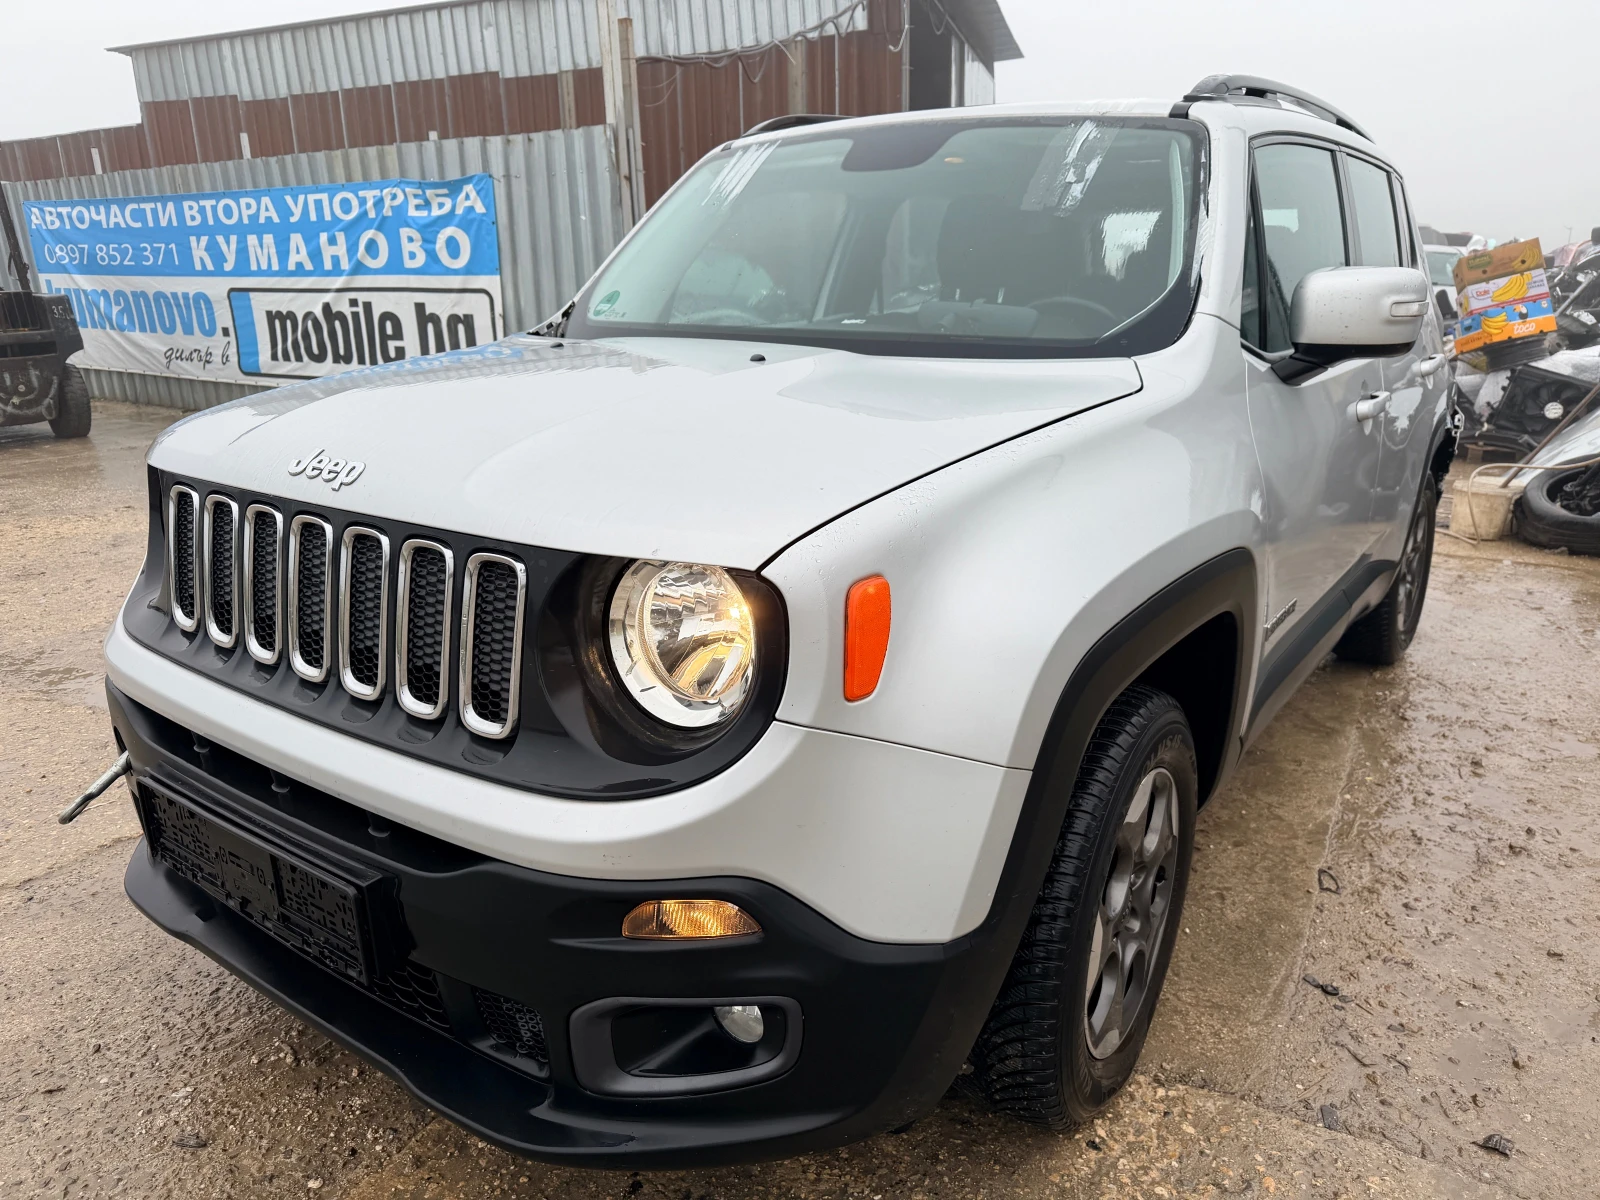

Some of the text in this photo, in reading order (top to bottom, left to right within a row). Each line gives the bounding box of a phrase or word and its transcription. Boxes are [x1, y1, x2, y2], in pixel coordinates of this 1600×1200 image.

[31, 184, 487, 230] АВТОЧАСТИ ВТОРА УПОТРЕБА
[44, 242, 179, 266] 0897 852 371
[189, 226, 471, 272] КУМАНОВО
[287, 447, 366, 492] Jeep
